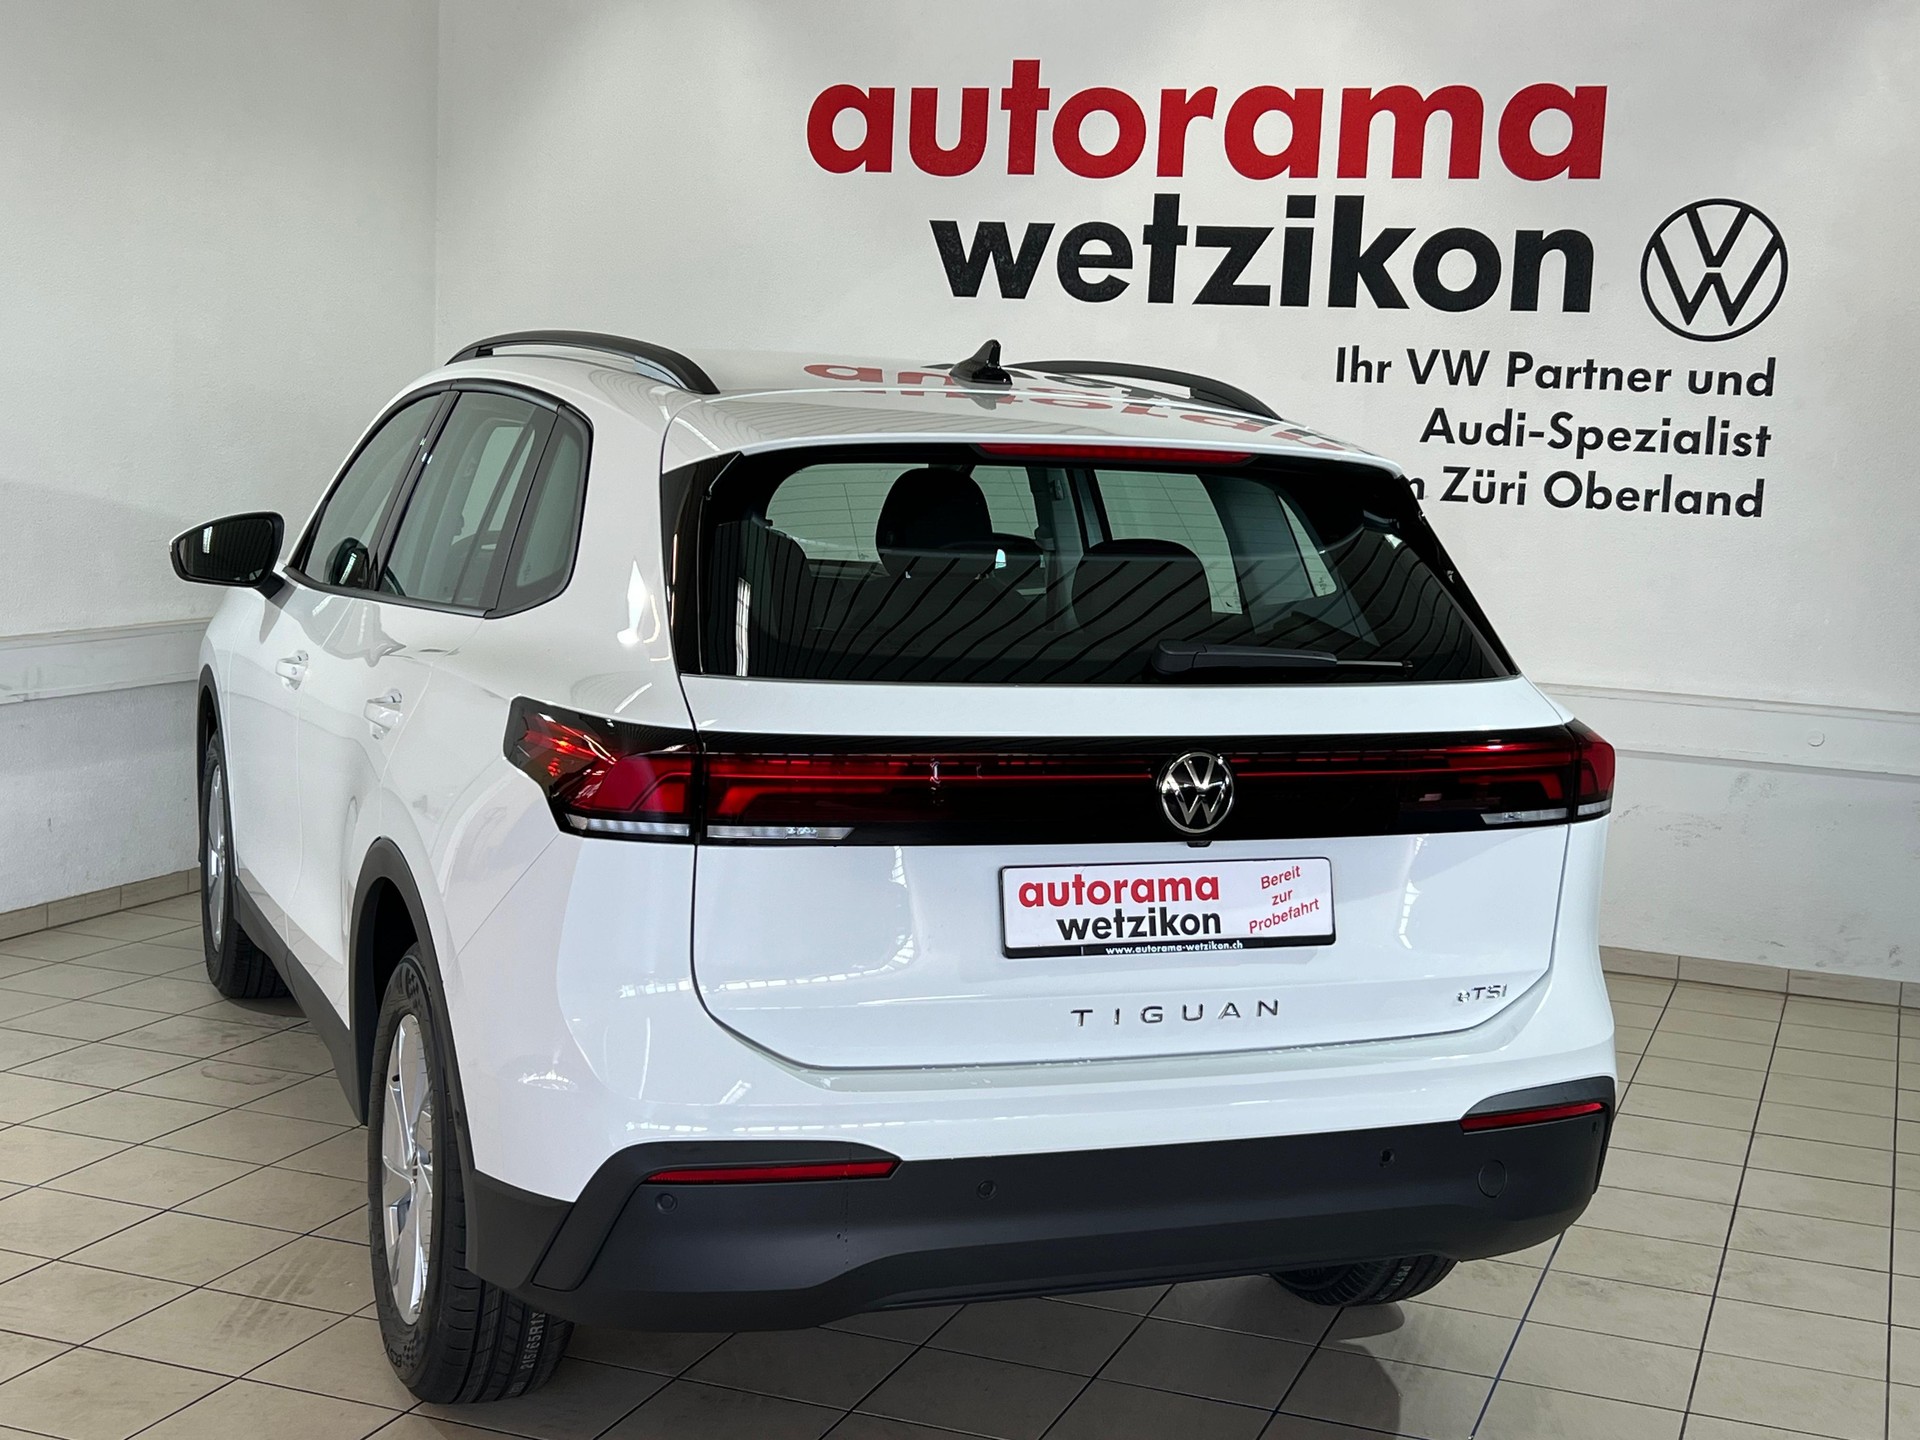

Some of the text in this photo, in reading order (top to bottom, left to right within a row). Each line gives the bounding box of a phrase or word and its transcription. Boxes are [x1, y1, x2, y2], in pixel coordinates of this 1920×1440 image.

[806, 58, 1608, 181] autorama
[929, 193, 1594, 313] wetzikon
[1336, 345, 1777, 397] Ihr VW Partner und
[1419, 407, 1772, 460] Audi-Spezialist
[1439, 465, 1528, 506] Züri
[1543, 470, 1765, 518] Oberland
[1018, 874, 1220, 908] autorama
[1260, 865, 1301, 890] Bereit
[1271, 888, 1293, 906] zur
[1056, 907, 1222, 941] wetzikon
[1248, 897, 1320, 934] Probefahrt
[1105, 940, 1244, 955] www.autorama-wetzikon.ch
[1070, 999, 1280, 1027] TIGUAN
